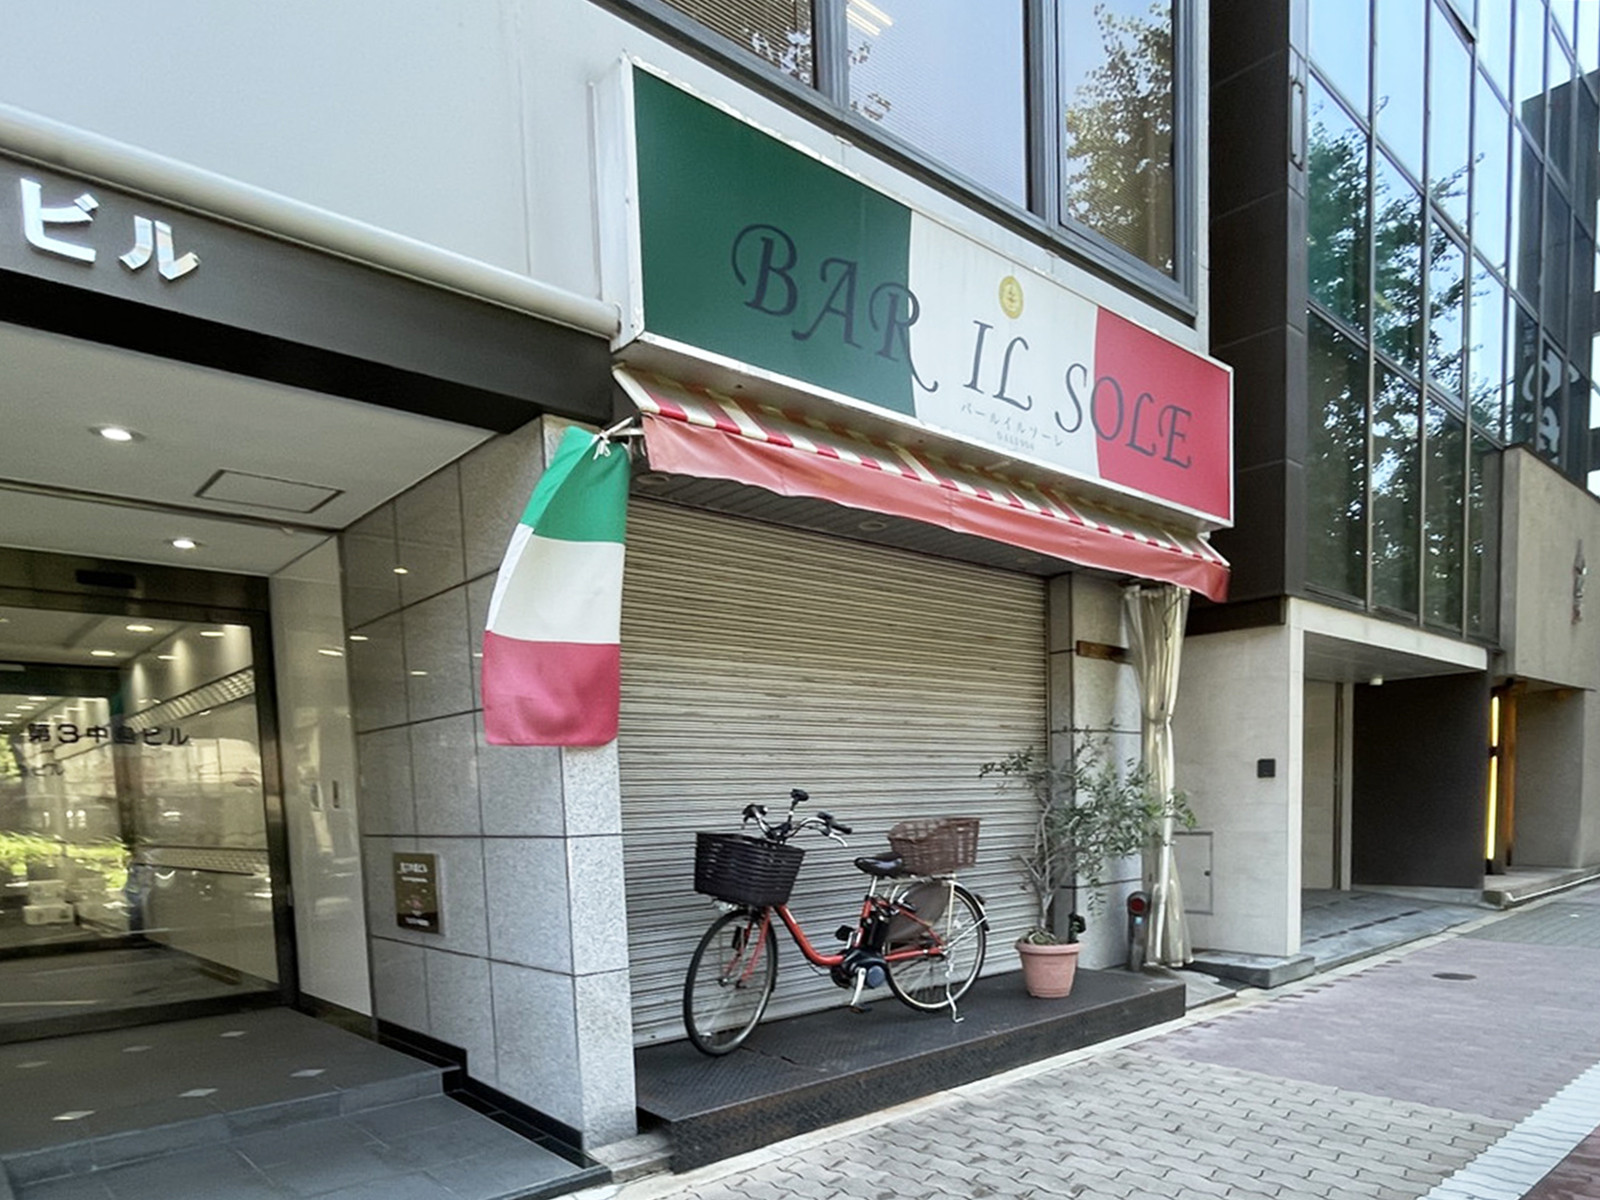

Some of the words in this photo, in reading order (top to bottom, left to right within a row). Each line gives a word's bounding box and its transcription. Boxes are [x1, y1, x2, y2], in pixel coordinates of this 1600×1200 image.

[20, 178, 201, 281] ビル
[731, 223, 939, 393] BAR
[963, 319, 1033, 411] IL
[1054, 362, 1193, 470] SOLE
